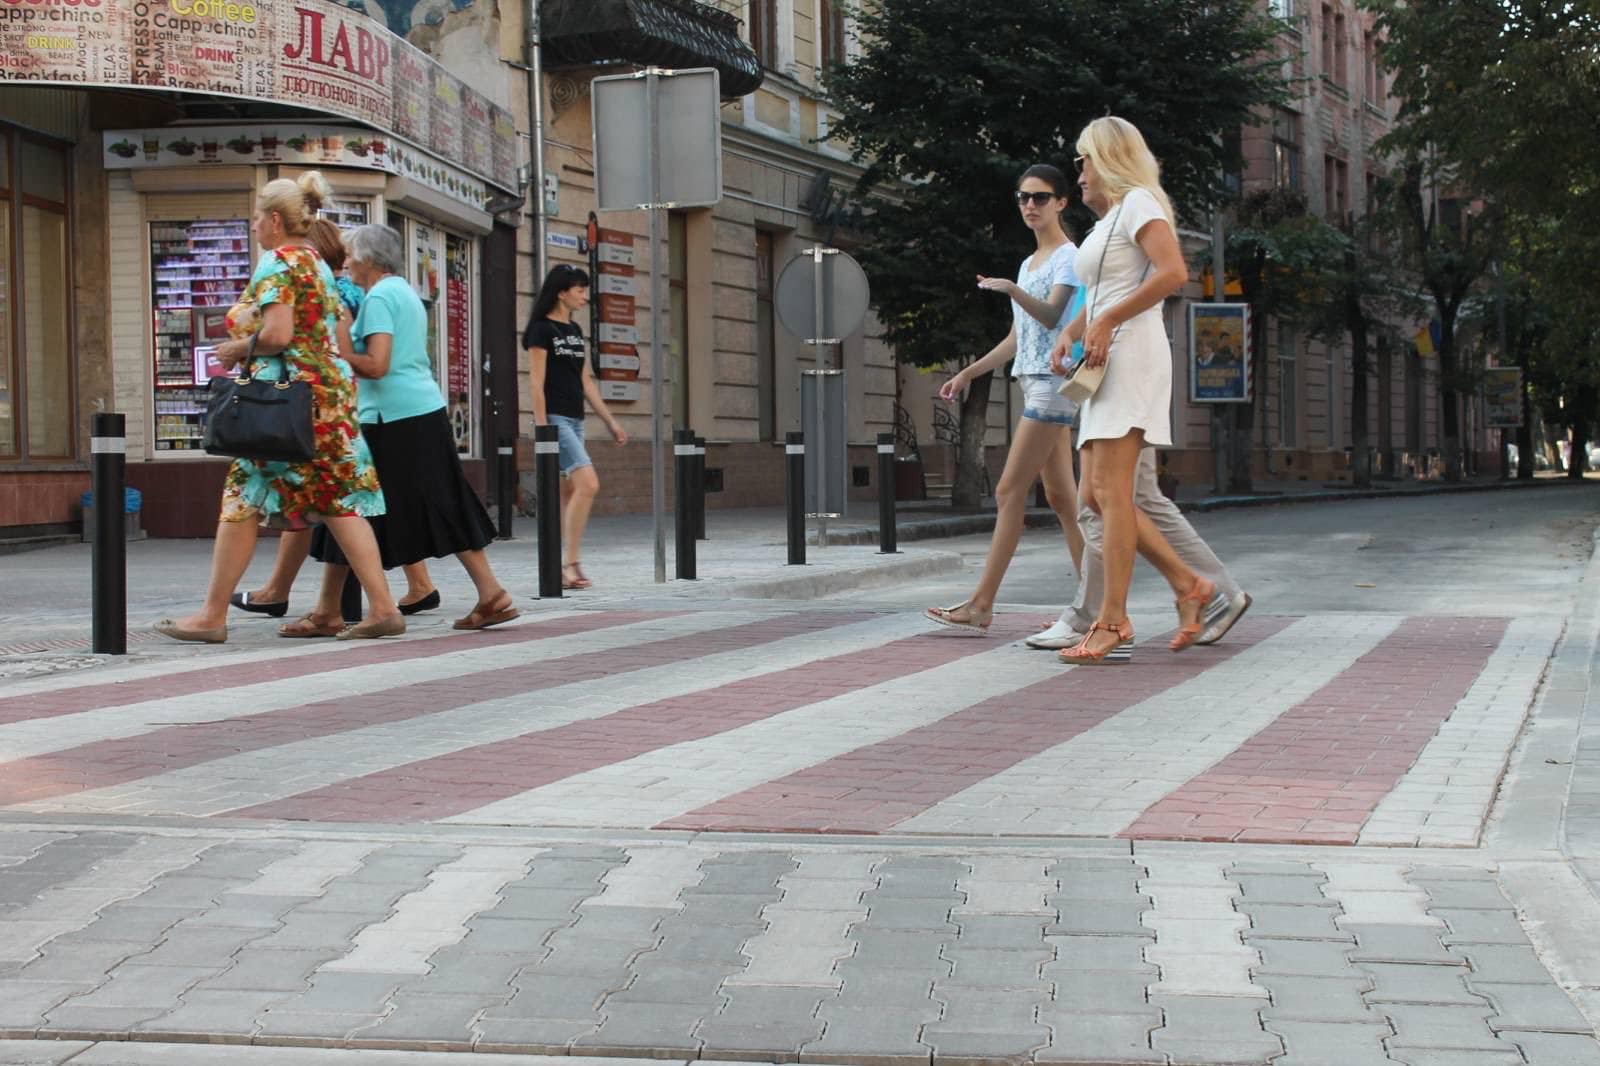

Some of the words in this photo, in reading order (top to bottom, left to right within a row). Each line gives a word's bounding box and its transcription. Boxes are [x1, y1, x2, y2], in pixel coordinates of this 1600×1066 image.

[170, 0, 256, 24] Coffee
[27, 36, 75, 49] DRINK
[282, 7, 390, 87] ЛАВР
[195, 47, 235, 64] DRINK
[168, 63, 207, 78] Black
